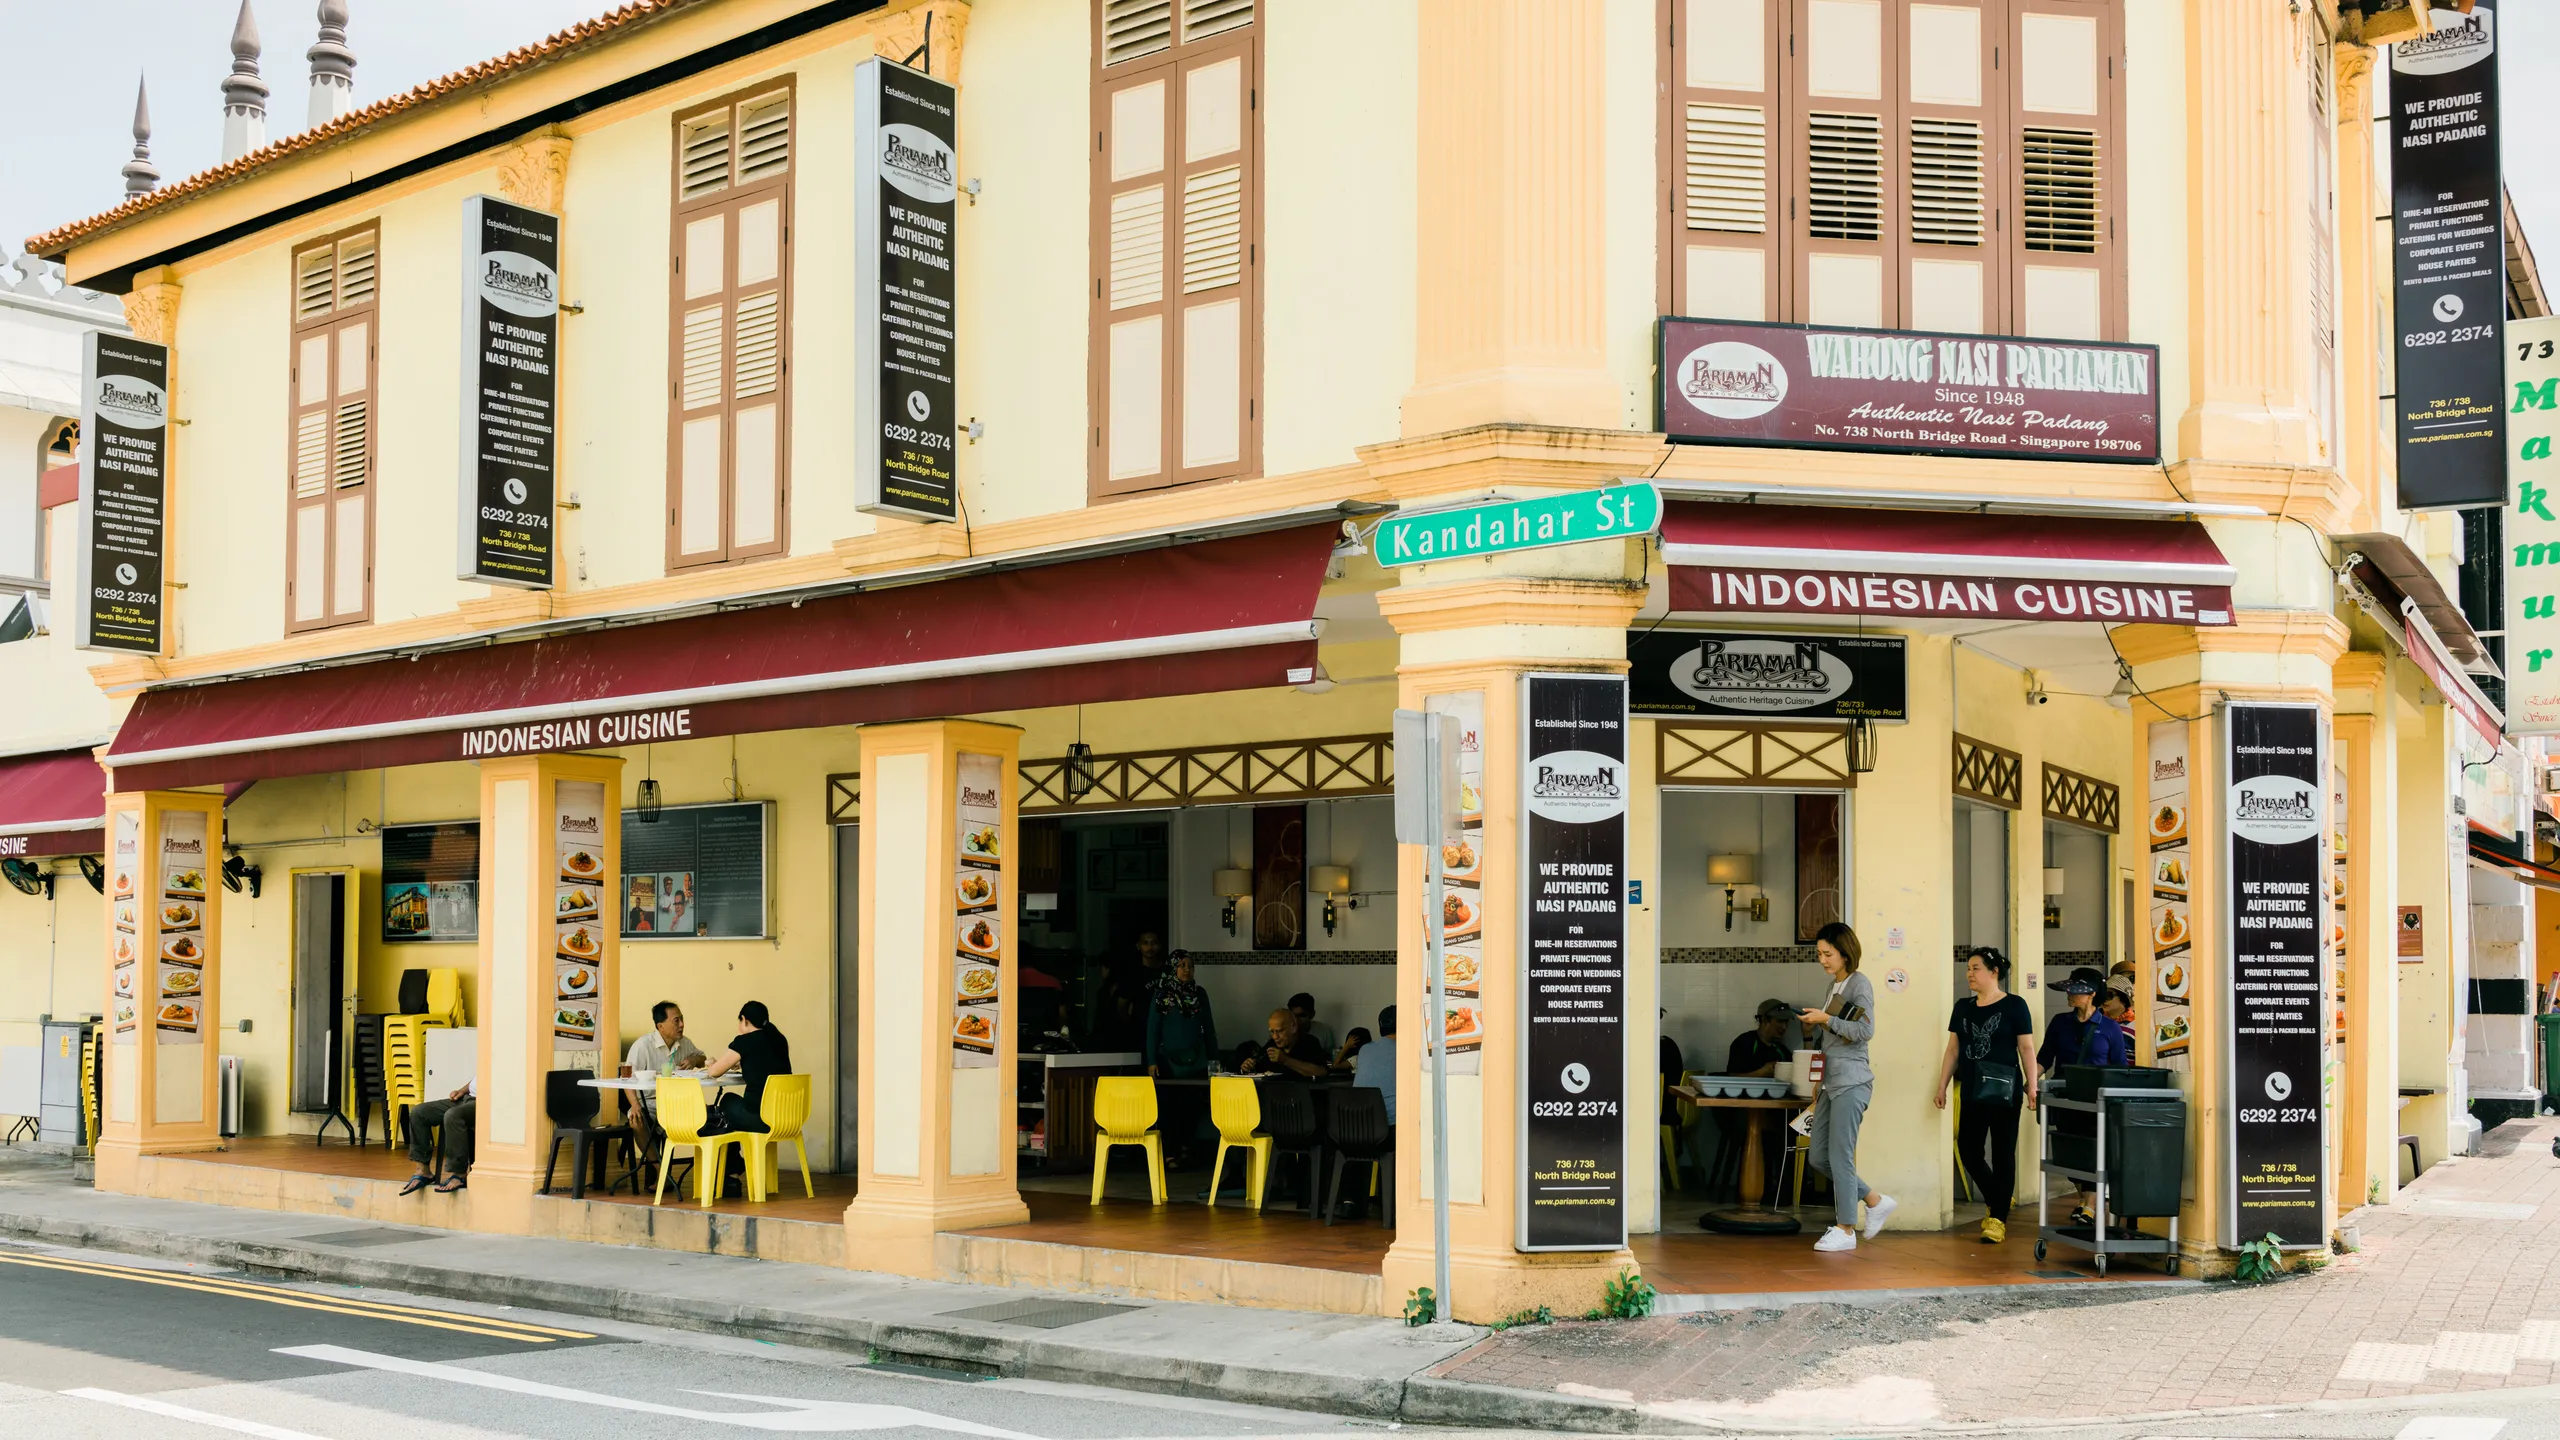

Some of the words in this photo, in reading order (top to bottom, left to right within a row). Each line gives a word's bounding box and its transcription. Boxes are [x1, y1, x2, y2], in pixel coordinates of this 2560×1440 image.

[2404, 101, 2425, 114] WE
[2428, 92, 2482, 111] PROVIDE
[2409, 109, 2478, 130] AUTHENTIC
[2402, 133, 2432, 148] NASI
[2435, 124, 2486, 143] PADANG
[886, 133, 950, 175] PARIAMAN
[889, 205, 905, 221] WE
[907, 211, 947, 234] PROVIDE
[892, 225, 944, 251] AUTHENTIC
[886, 241, 910, 259] NASI
[912, 249, 950, 271] PADANG
[486, 259, 552, 290] PARIAMAN
[488, 320, 505, 334] WE
[506, 325, 547, 344] PROVIDE
[2404, 330, 2447, 347] 6292
[2451, 325, 2494, 342] 2374
[491, 338, 544, 358] AUTHENTIC
[485, 351, 509, 366] NASI
[510, 357, 549, 375] PADANG
[1805, 333, 1934, 383] WARONG
[1937, 340, 2000, 387] NASI
[2004, 344, 2150, 395] PARIAMAN
[1689, 357, 1777, 391] PARIAMAN
[100, 381, 161, 407] PARIAMAN
[1935, 388, 1978, 404] Since
[1985, 391, 2025, 406] 1948
[1847, 401, 1955, 423] Authentic
[1959, 406, 2015, 426] Nasi
[2021, 409, 2110, 436] Padang
[102, 433, 118, 444] WE
[119, 436, 157, 451] PROVIDE
[884, 423, 917, 443] 6292
[920, 431, 951, 451] 2374
[1815, 424, 1840, 435] No.
[1843, 425, 1869, 437] 738
[1872, 427, 1914, 439] North
[1918, 430, 1966, 444] Bridge
[1970, 432, 2007, 444] Road
[2020, 435, 2090, 449] Singapore
[2094, 434, 2142, 451] 198706
[2408, 430, 2493, 443] www.pariaman.com.sg
[105, 447, 154, 463] AUTHENTIC
[99, 459, 122, 471] NASI
[123, 462, 158, 477] PADANG
[481, 506, 514, 523] 6292
[516, 512, 549, 529] 2374
[1393, 507, 1576, 559] Kandahar
[1595, 493, 1635, 532] St
[94, 587, 125, 601] 6292
[127, 591, 157, 605] 2374
[1710, 572, 1999, 613] INDONESIAN
[2014, 584, 2196, 620] CUISINE
[1871, 640, 1887, 648] Since
[1696, 637, 1824, 679] PARIAMAN
[1707, 695, 1748, 706] Authentic
[1749, 696, 1783, 706] Heritage
[1784, 696, 1817, 708] Cuisine
[1835, 706, 1856, 715] North
[1882, 708, 1902, 716] Road
[1535, 719, 1577, 728] Established
[1578, 719, 1599, 729] Since
[1600, 720, 1619, 729] 1948
[462, 720, 590, 755] INDONESIAN
[598, 709, 691, 743] CUISINE
[1536, 765, 1618, 790] PARIAMAN
[1568, 799, 1591, 808] Heritage
[2238, 789, 2313, 813] PARIAMAN
[1539, 863, 1559, 876] WE
[1562, 863, 1613, 876] PROVIDE
[1543, 881, 1609, 894] AUTHENTIC
[2242, 882, 2261, 894] WE
[2263, 882, 2310, 894] PROVIDE
[1536, 899, 1565, 912] NASI
[1568, 900, 1616, 913] PADANG
[2246, 899, 2306, 912] AUTHENTIC
[1568, 926, 1584, 934] FOR
[2240, 916, 2267, 929] NASI
[2269, 917, 2313, 929] PADANG
[1534, 939, 1563, 948] DINE-IN
[1564, 940, 1618, 948] RESERVATIONS
[2270, 941, 2284, 950] FOR
[1540, 954, 1570, 963] PRIVATE
[1571, 954, 1612, 963] FUNCTIONS
[2239, 954, 2265, 963] DINE-IN
[2266, 954, 2315, 963] RESERVATIONS
[1530, 969, 1566, 978] CATERING
[1567, 969, 1582, 978] FOR
[1582, 969, 1622, 978] WEDDINGS
[2244, 968, 2272, 977] PRIVATE
[2272, 969, 2310, 977] FUNCTIONS
[1540, 984, 1583, 993] CORPORATE
[1584, 984, 1612, 993] EVENTS
[2235, 982, 2269, 992] CATERING
[2269, 982, 2283, 991] FOR
[2283, 983, 2319, 991] WEDDINGS
[1547, 1000, 1573, 1009] HOUSE
[1573, 1000, 1604, 1009] PARTIES
[2244, 997, 2284, 1006] CORPORATE
[2284, 997, 2310, 1006] EVENTS
[2251, 1012, 2275, 1021] HOUSE
[2275, 1012, 2303, 1020] PARTIES
[1533, 1101, 1574, 1116] 6292
[1577, 1101, 1618, 1116] 2374
[2239, 1108, 2277, 1123] 6292
[2280, 1108, 2317, 1122] 2374
[1555, 1160, 1572, 1168] 736
[1579, 1159, 1595, 1168] 738
[2261, 1164, 2276, 1172] 736
[2282, 1164, 2297, 1172] 738
[1535, 1171, 1560, 1180] North
[1561, 1171, 1591, 1181] Bridge
[1592, 1171, 1616, 1180] Road
[2242, 1175, 2265, 1183] North
[2266, 1175, 2293, 1184] Bridge
[2294, 1174, 2316, 1183] Road
[1534, 1198, 1616, 1206] www.pariaman.com.sg
[2242, 1200, 2316, 1208] www.pariaman.com.sg
